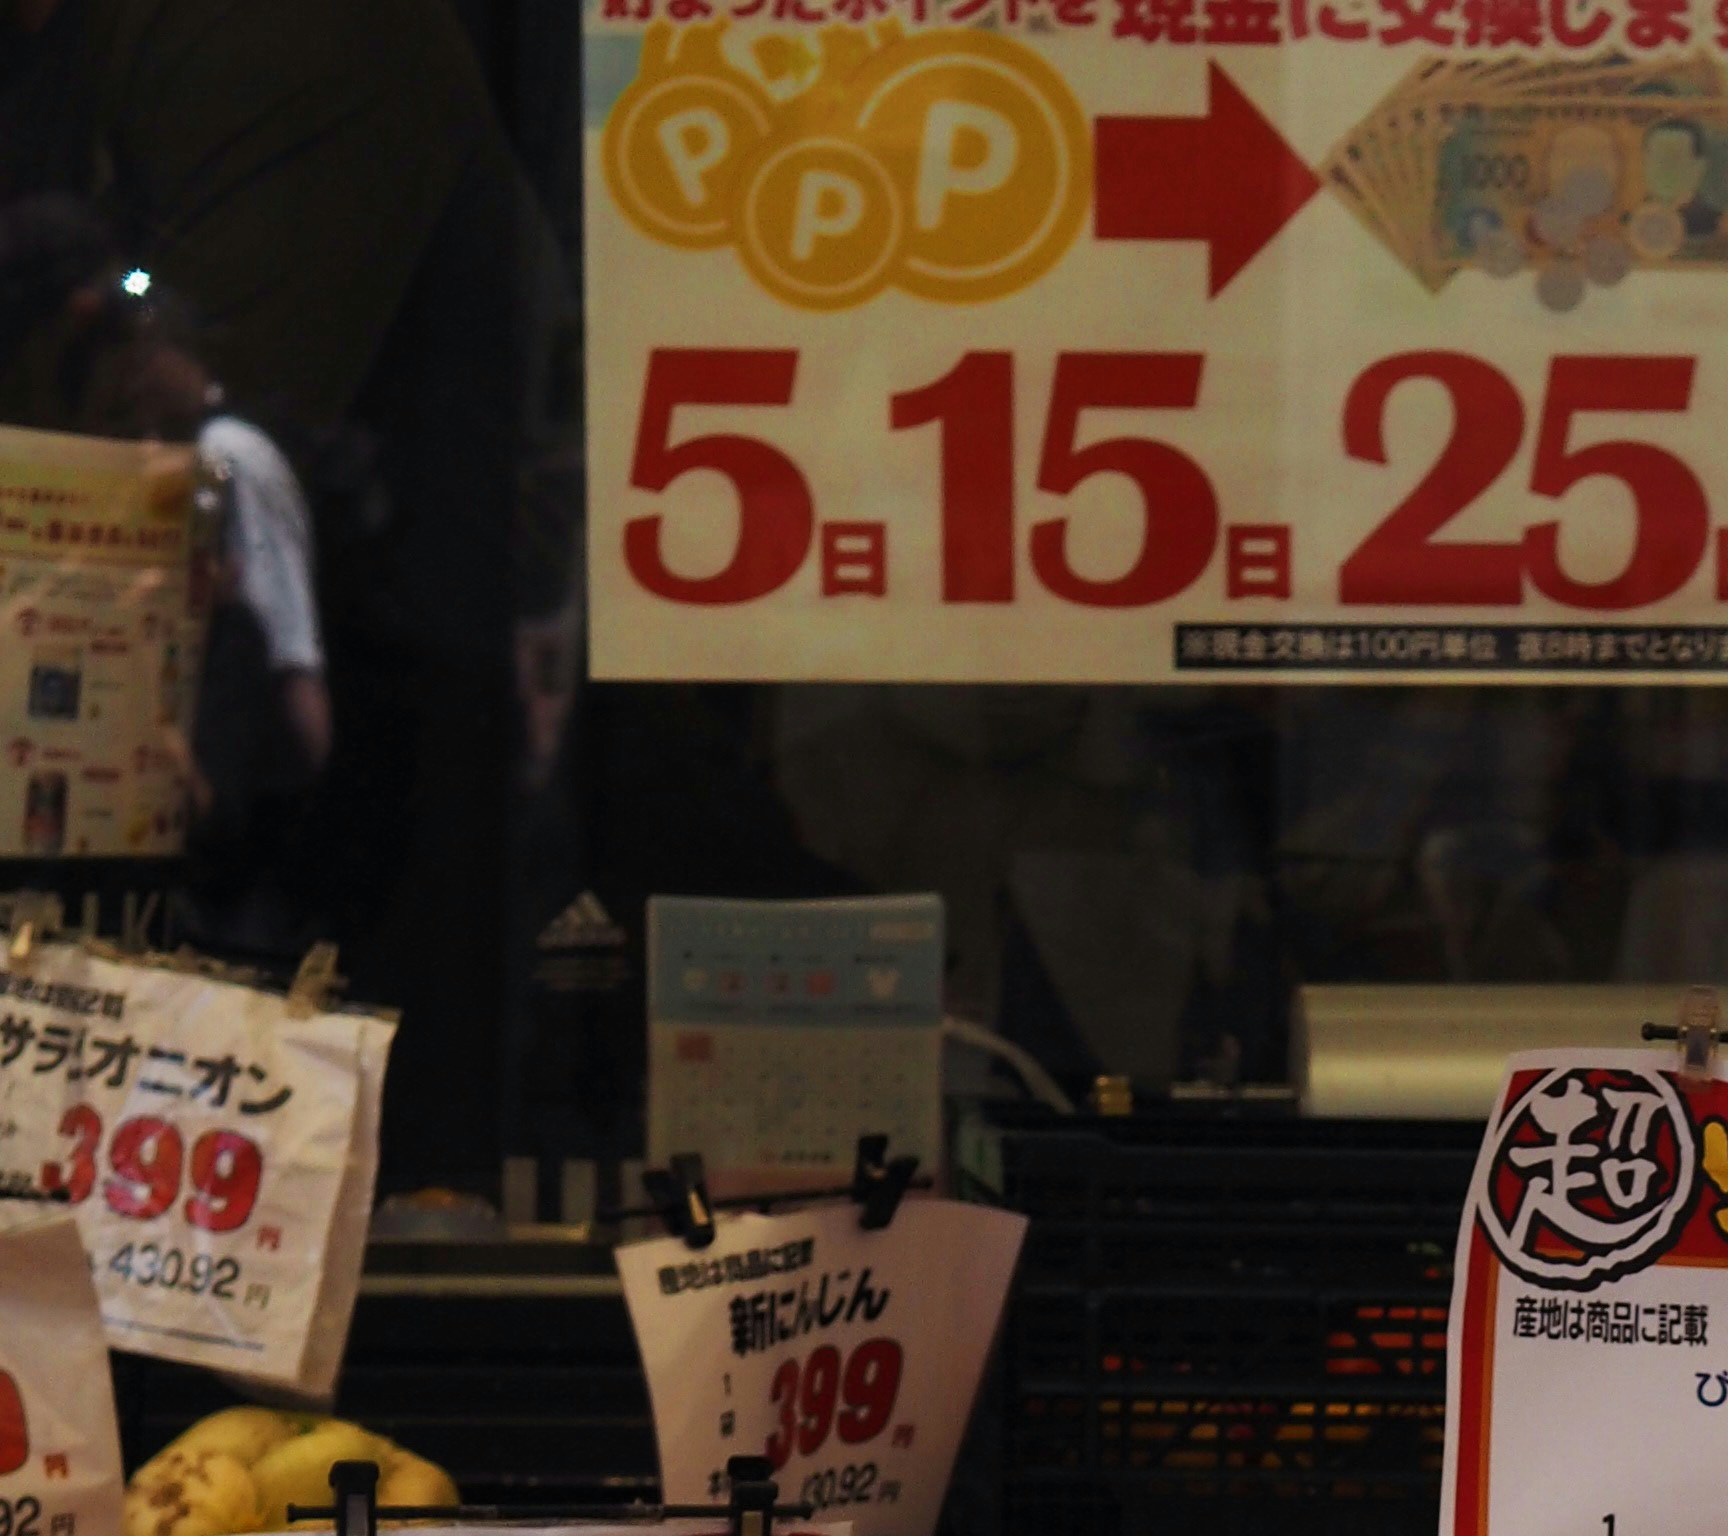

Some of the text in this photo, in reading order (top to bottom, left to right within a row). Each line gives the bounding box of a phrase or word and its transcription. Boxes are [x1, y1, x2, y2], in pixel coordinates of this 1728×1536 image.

[1512, 1296, 1710, 1348] 産地は商品に記載
